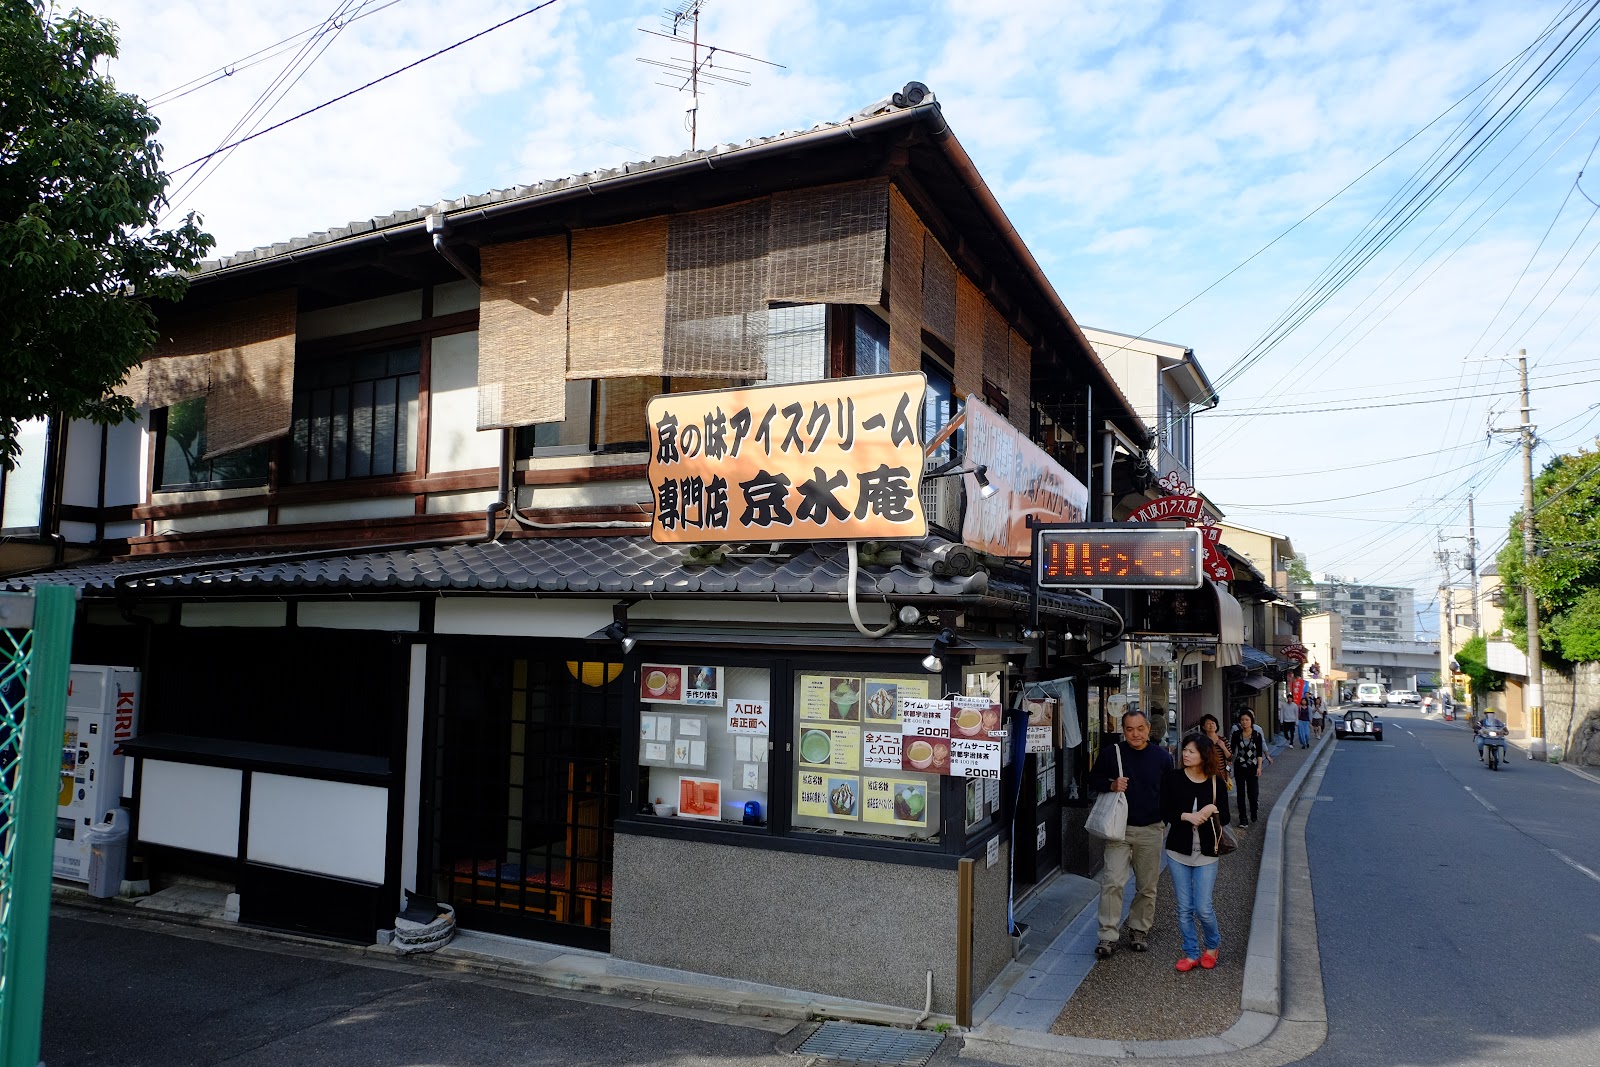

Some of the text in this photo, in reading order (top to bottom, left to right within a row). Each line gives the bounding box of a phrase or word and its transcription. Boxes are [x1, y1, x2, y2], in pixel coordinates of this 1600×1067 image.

[656, 392, 915, 464] 京の味アイスクリーム
[657, 464, 914, 530] 専門店 京水庵
[735, 703, 763, 715] 入口は
[904, 702, 951, 710] タイムサービス
[903, 711, 941, 719] 京都宇治抹茶
[113, 692, 134, 755] KIRIN
[729, 717, 767, 729] 店正面へ
[917, 727, 949, 737] 200円
[865, 733, 900, 744] 全メニュ
[951, 741, 999, 751] タイムサービス
[950, 751, 989, 759] 京都宇治抹茶
[965, 768, 998, 778] 200円
